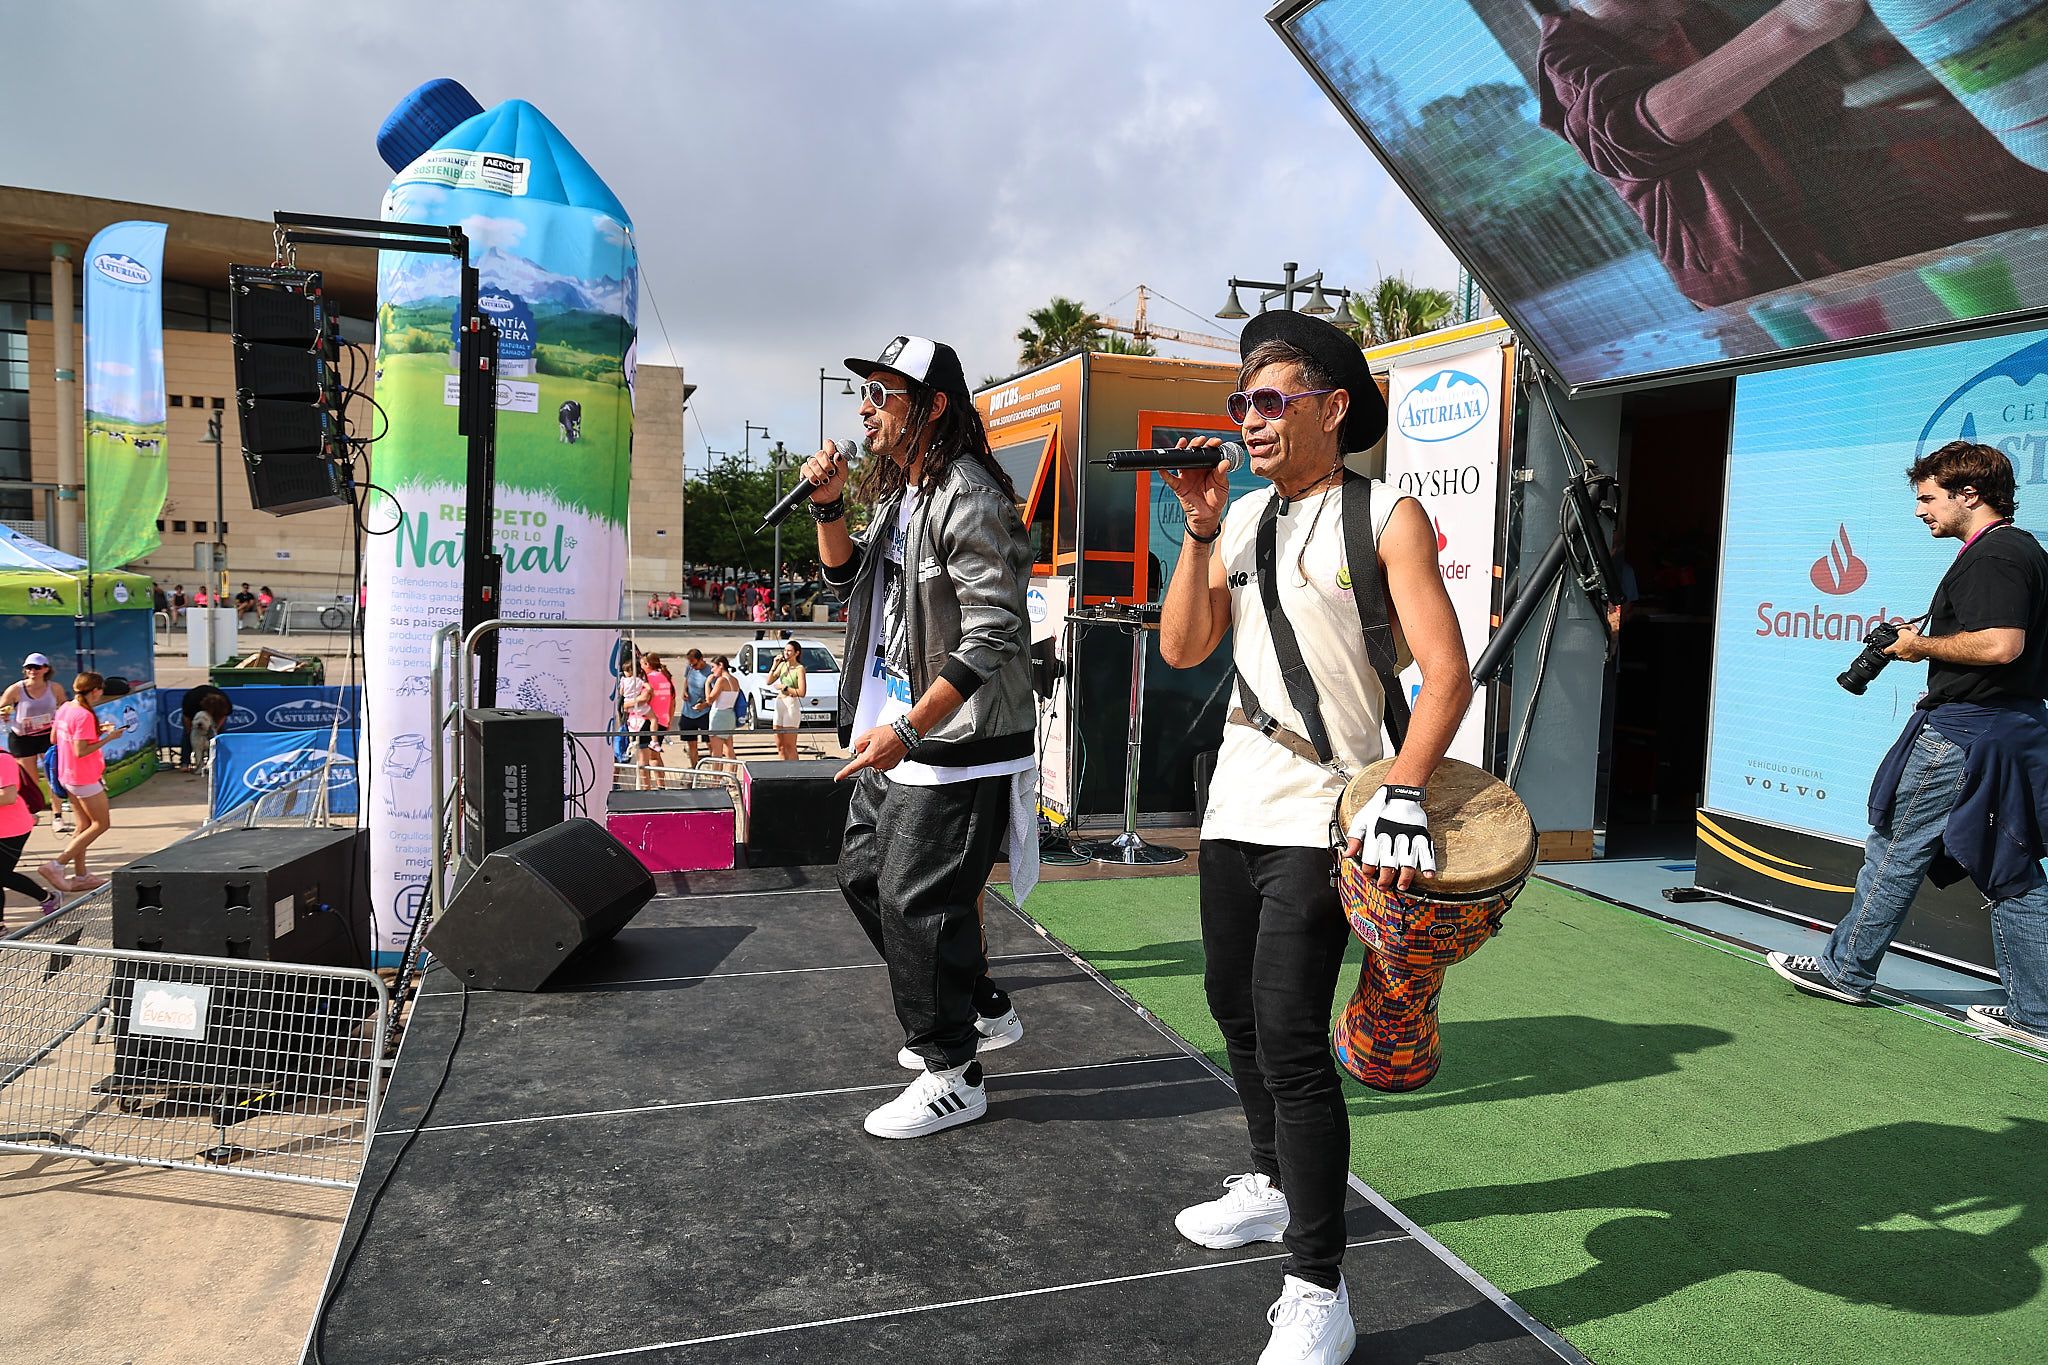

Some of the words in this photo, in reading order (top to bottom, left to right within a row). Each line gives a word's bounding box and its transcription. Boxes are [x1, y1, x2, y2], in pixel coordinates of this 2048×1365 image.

[413, 164, 476, 180] SOSTENIBLES
[485, 158, 520, 172] AENOR
[98, 258, 147, 281] ASTURIANA
[490, 317, 526, 329] ANTÍA
[497, 329, 529, 341] DERA
[990, 386, 1019, 416] portos
[1402, 399, 1481, 427] ASTURIANA
[1399, 466, 1480, 496] OYSHO
[440, 504, 547, 527] REPETO
[396, 511, 570, 574] Natral
[492, 529, 518, 541] POR
[524, 532, 541, 542] LO
[392, 576, 448, 588] Defendemos
[524, 585, 535, 593] de
[538, 586, 576, 595] nuestras
[392, 591, 428, 601] familias
[430, 594, 464, 604] ganade
[538, 598, 565, 607] forma
[391, 604, 401, 612] de
[404, 604, 424, 613] vida
[501, 609, 536, 619] medio
[539, 610, 567, 620] rural.
[390, 618, 409, 626] sus
[1756, 602, 1914, 642] Santand
[388, 644, 425, 654] ayudan
[505, 637, 524, 646] que
[388, 658, 401, 666] las
[272, 712, 344, 722] ASTURIANA
[1791, 767, 1824, 780] OFICIAL
[1744, 776, 1826, 800] VOLVO
[503, 765, 520, 832] portos
[394, 872, 430, 882] Empre
